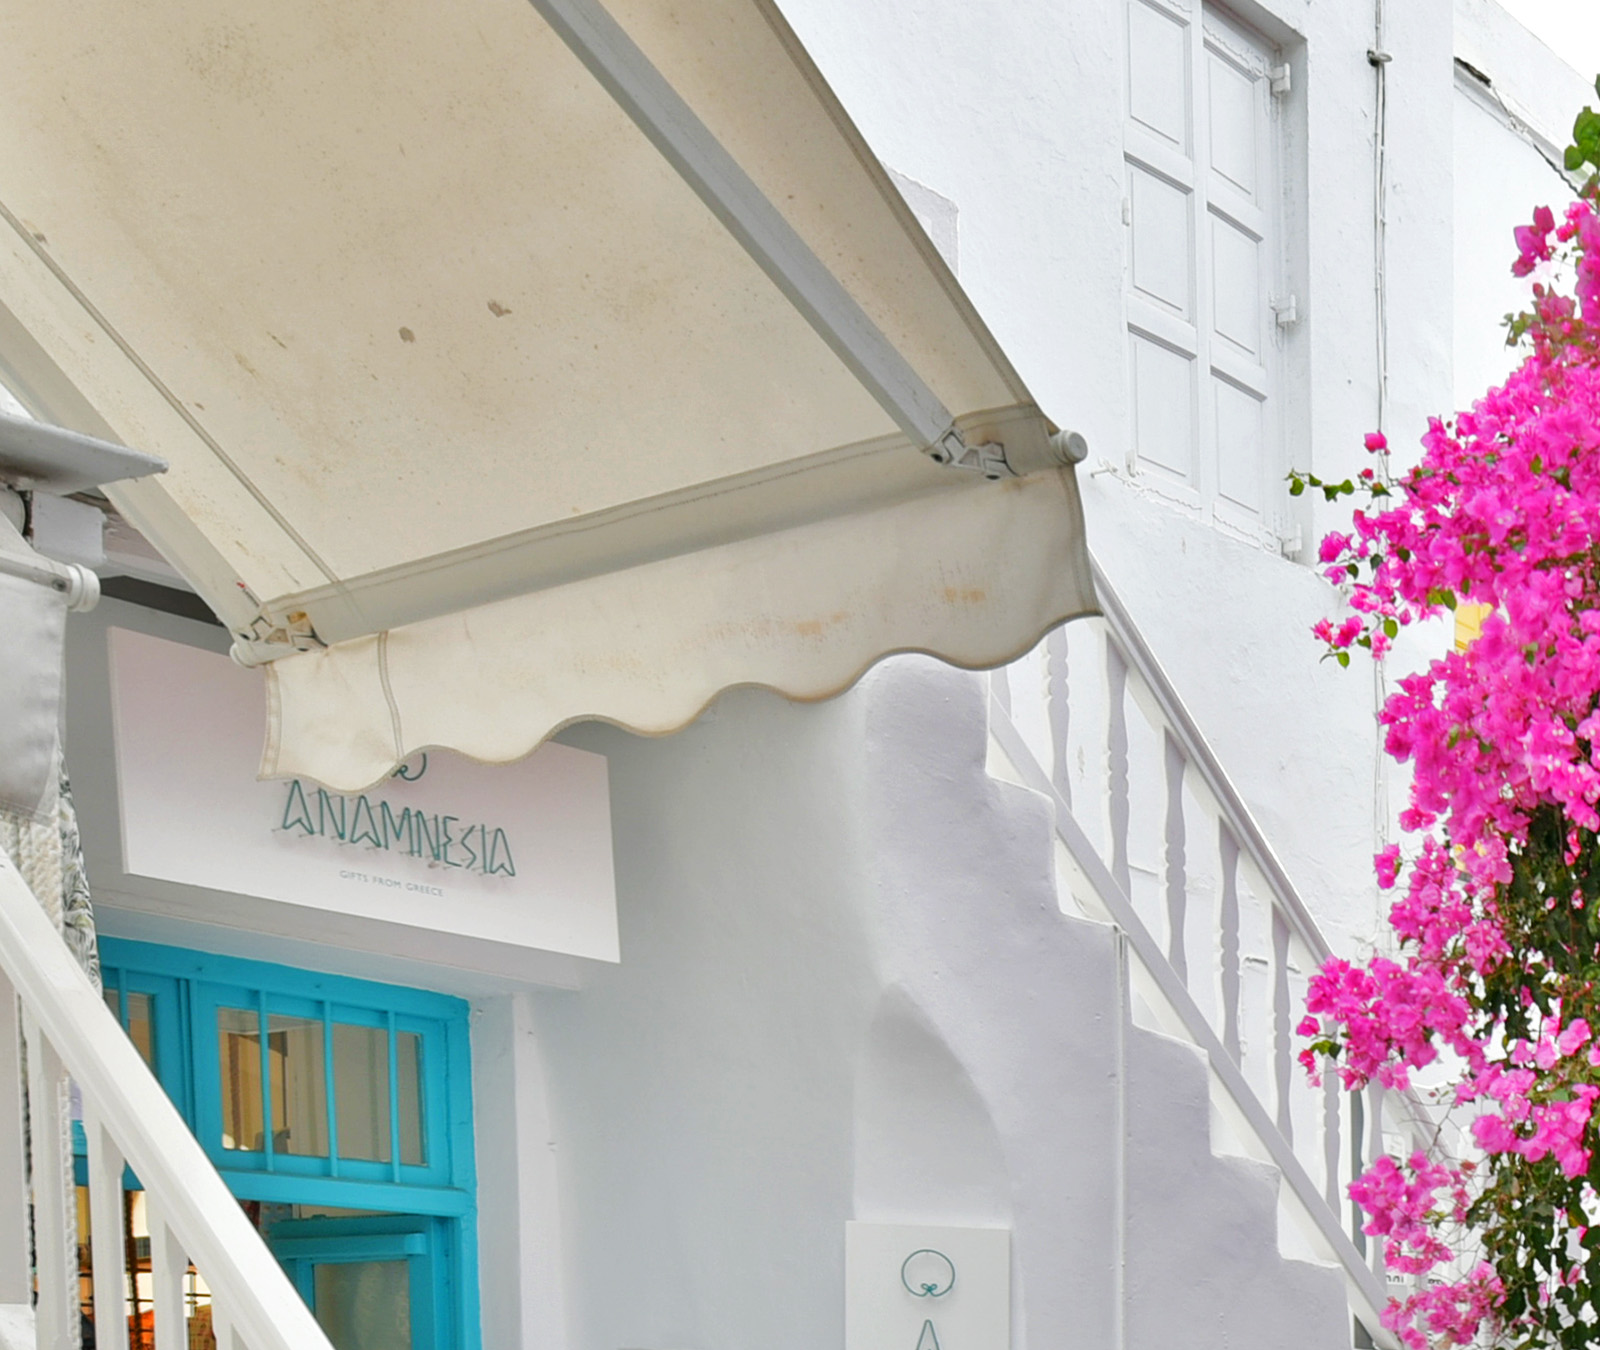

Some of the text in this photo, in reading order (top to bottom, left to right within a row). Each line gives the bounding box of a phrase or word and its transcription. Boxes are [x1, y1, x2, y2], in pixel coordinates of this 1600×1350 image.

[281, 778, 516, 877] ANAMNESIA
[338, 869, 444, 898] GIFTS FROM GREECE
